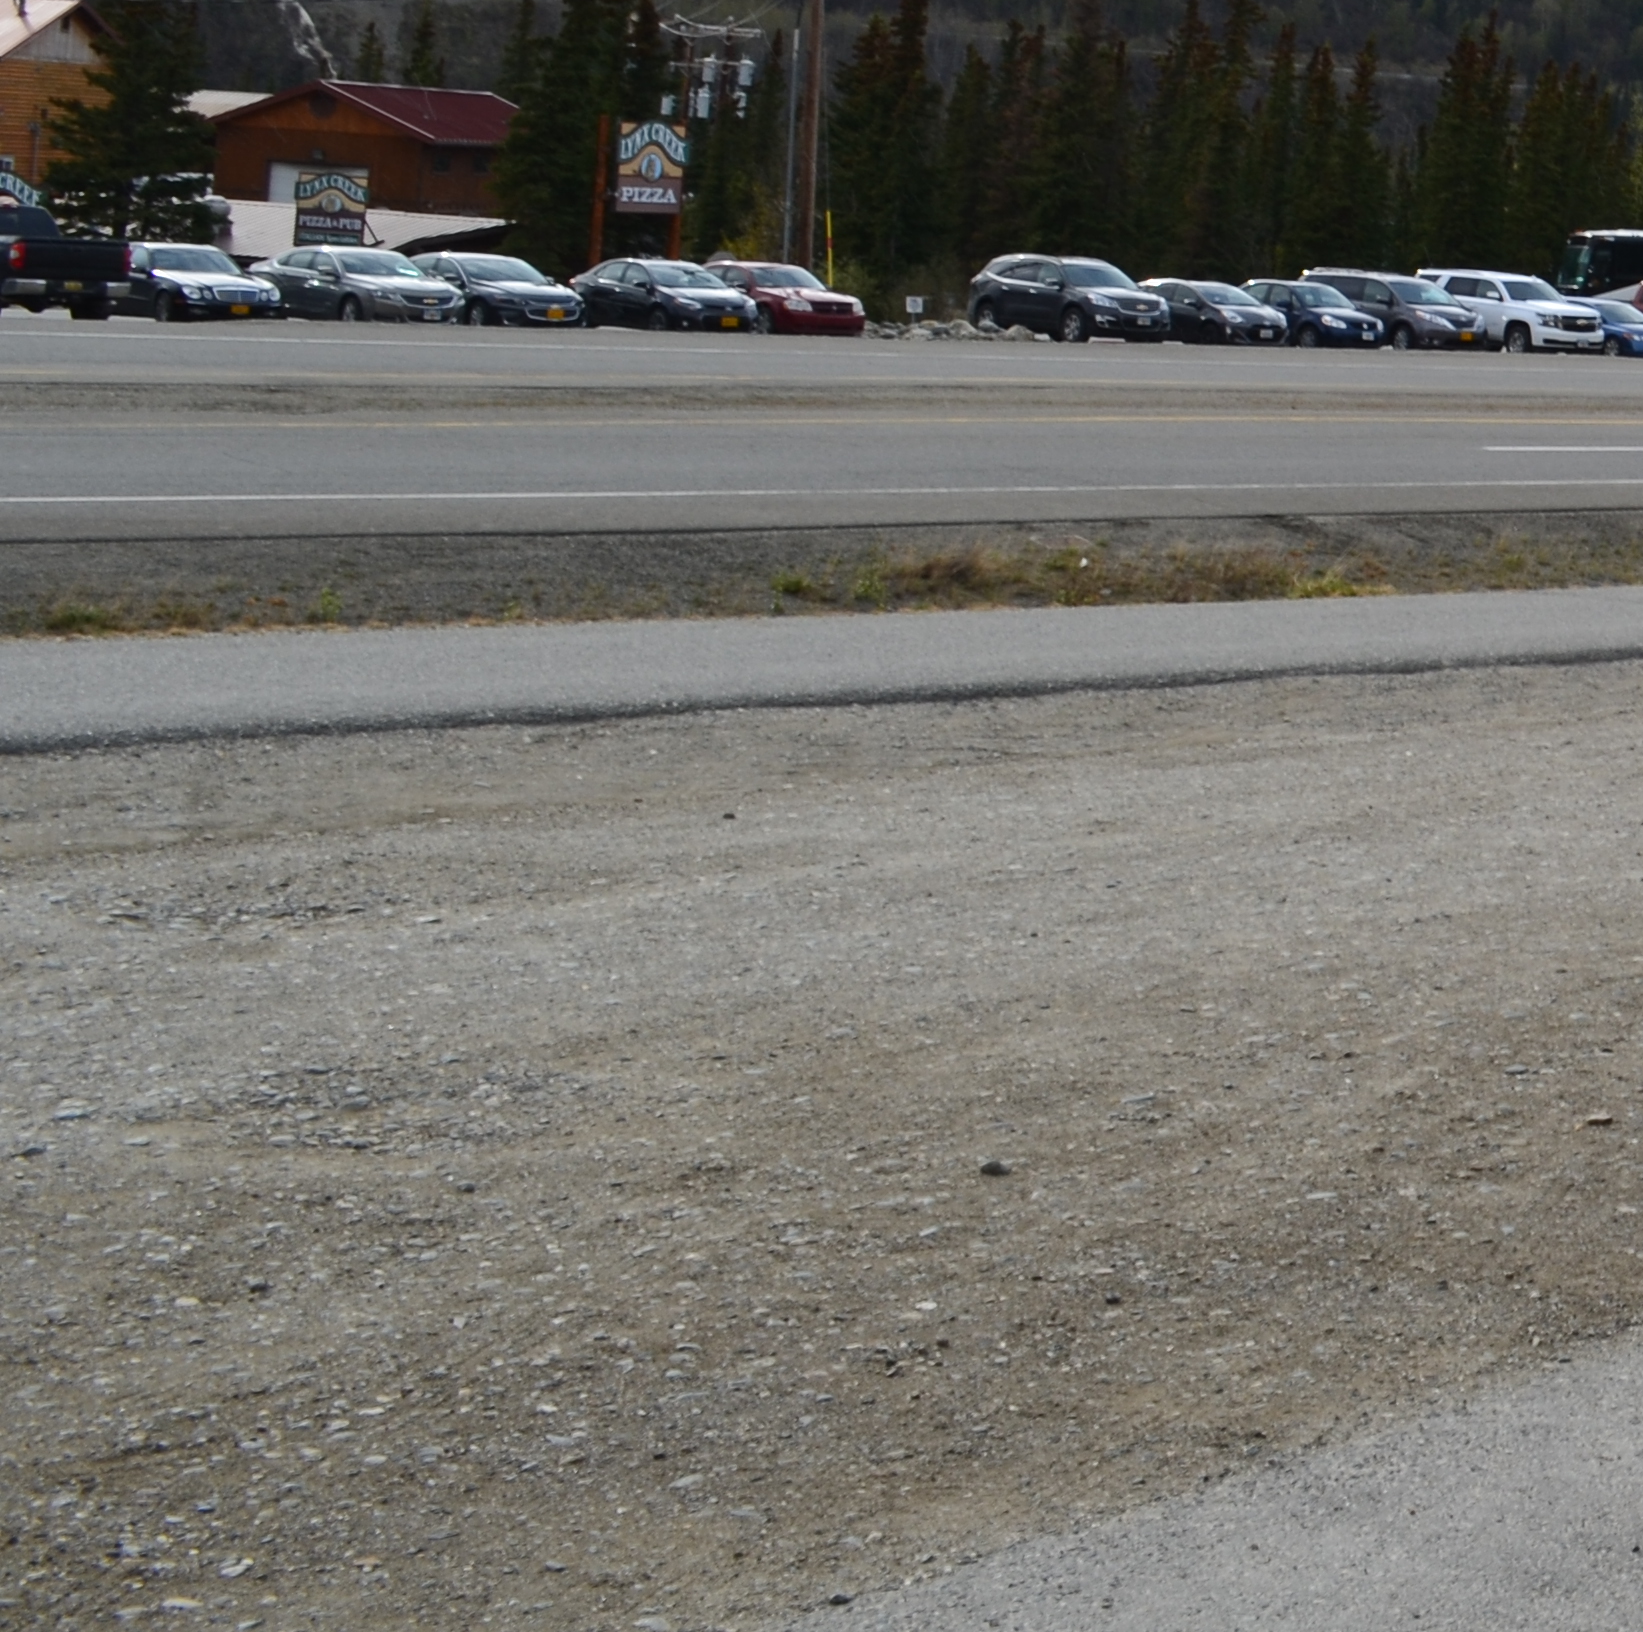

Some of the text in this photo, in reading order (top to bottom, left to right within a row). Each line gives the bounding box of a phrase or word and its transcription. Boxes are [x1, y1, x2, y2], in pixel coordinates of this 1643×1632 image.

[620, 123, 686, 163] LYNX CREEK
[300, 175, 366, 202] LYNX CREEK
[621, 187, 677, 204] PIZZA
[299, 214, 331, 228] PIZZA
[339, 217, 362, 230] PUB
